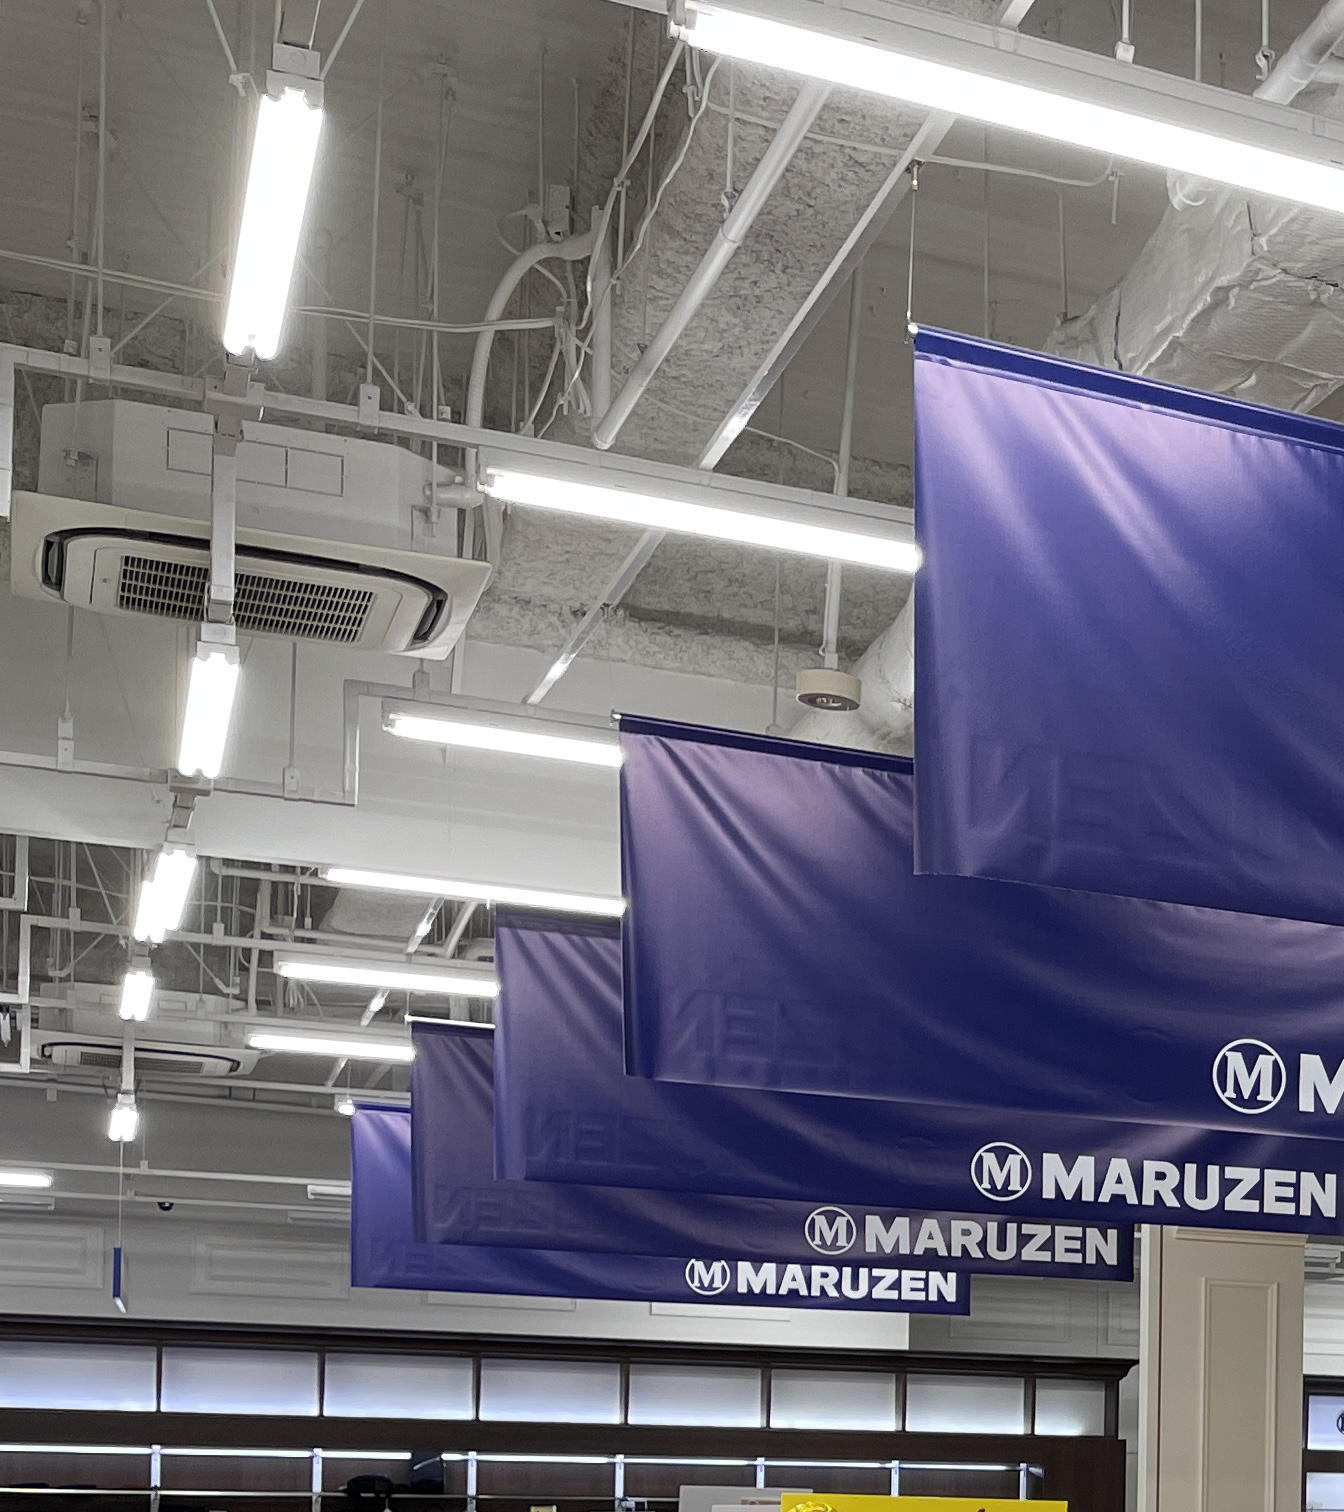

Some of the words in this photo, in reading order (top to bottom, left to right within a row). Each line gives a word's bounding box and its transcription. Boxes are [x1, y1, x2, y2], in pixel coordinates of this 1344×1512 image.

[1043, 1153, 1337, 1218] MARUZEN
[866, 1215, 1118, 1266] MARUZEN
[738, 1261, 957, 1302] MARUZEN
